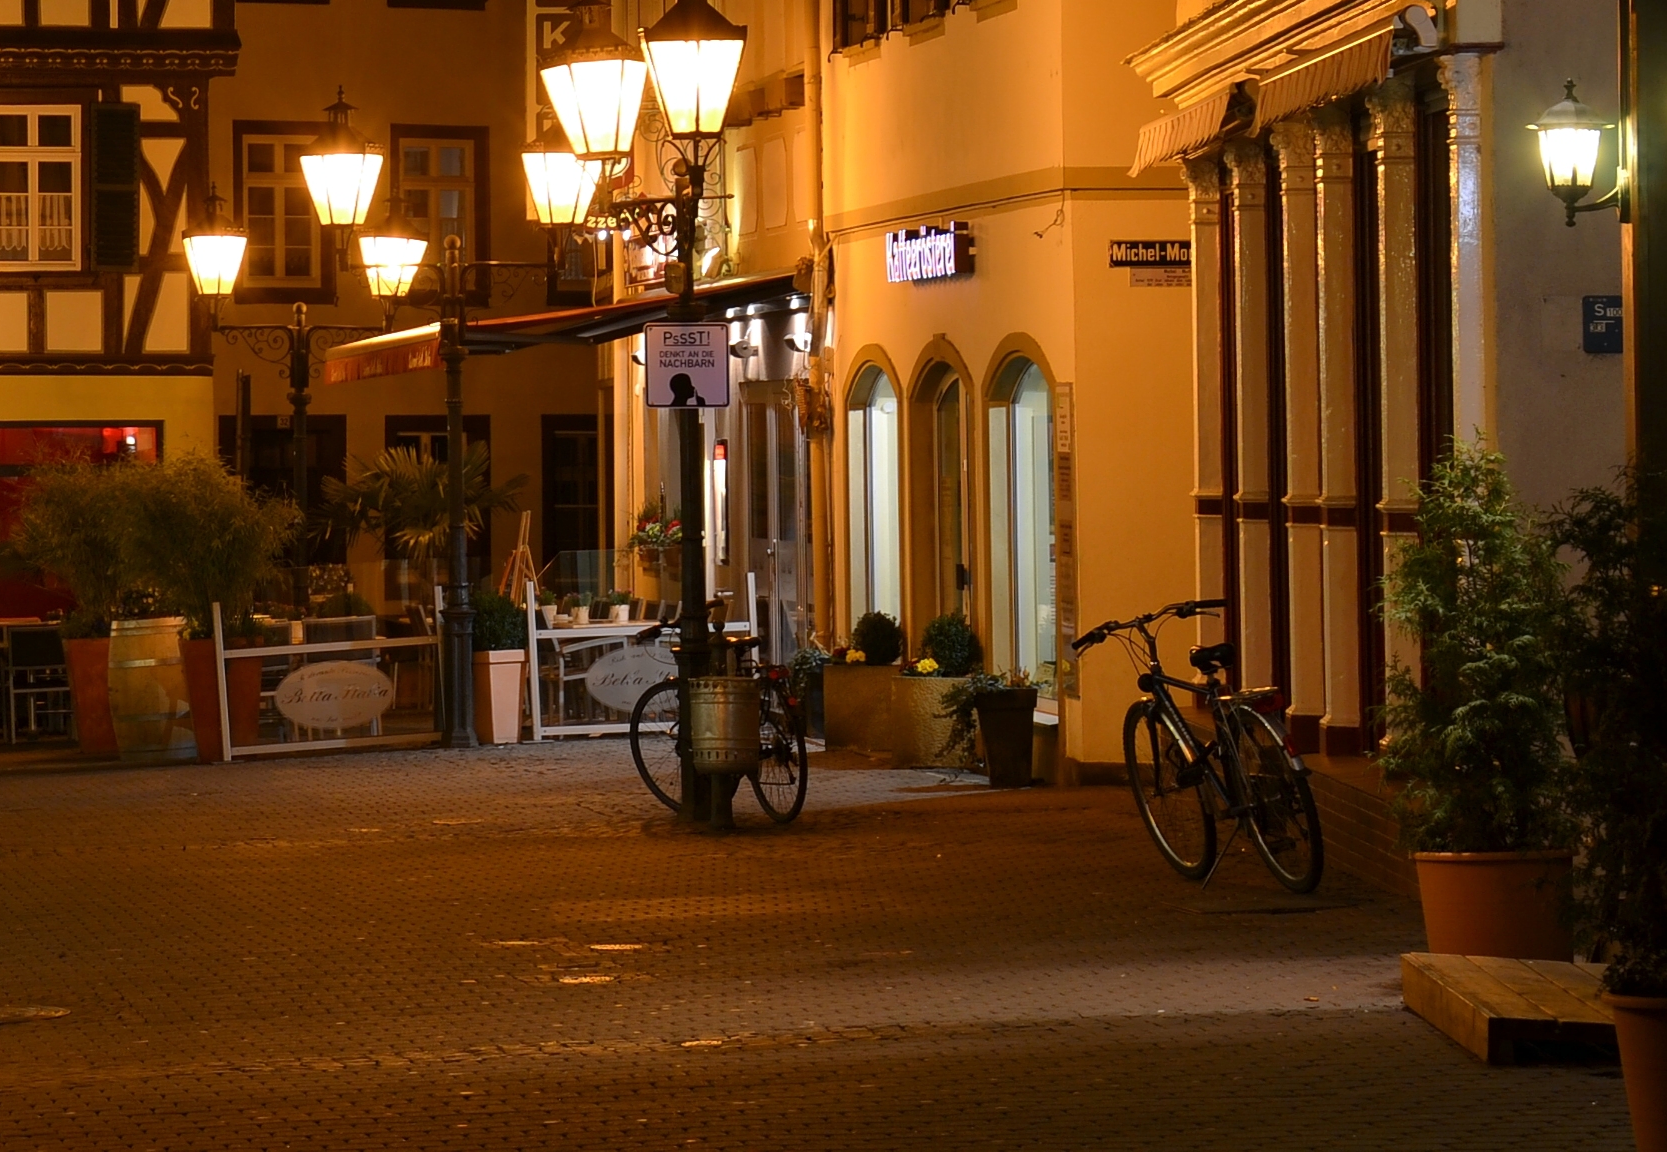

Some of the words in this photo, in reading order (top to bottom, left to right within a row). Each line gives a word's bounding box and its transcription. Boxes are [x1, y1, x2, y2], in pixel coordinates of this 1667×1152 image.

[886, 221, 956, 282] Kaffeerösterei
[1594, 303, 1605, 316] S
[659, 350, 685, 358] DENKT
[659, 359, 715, 368] NACHBARN
